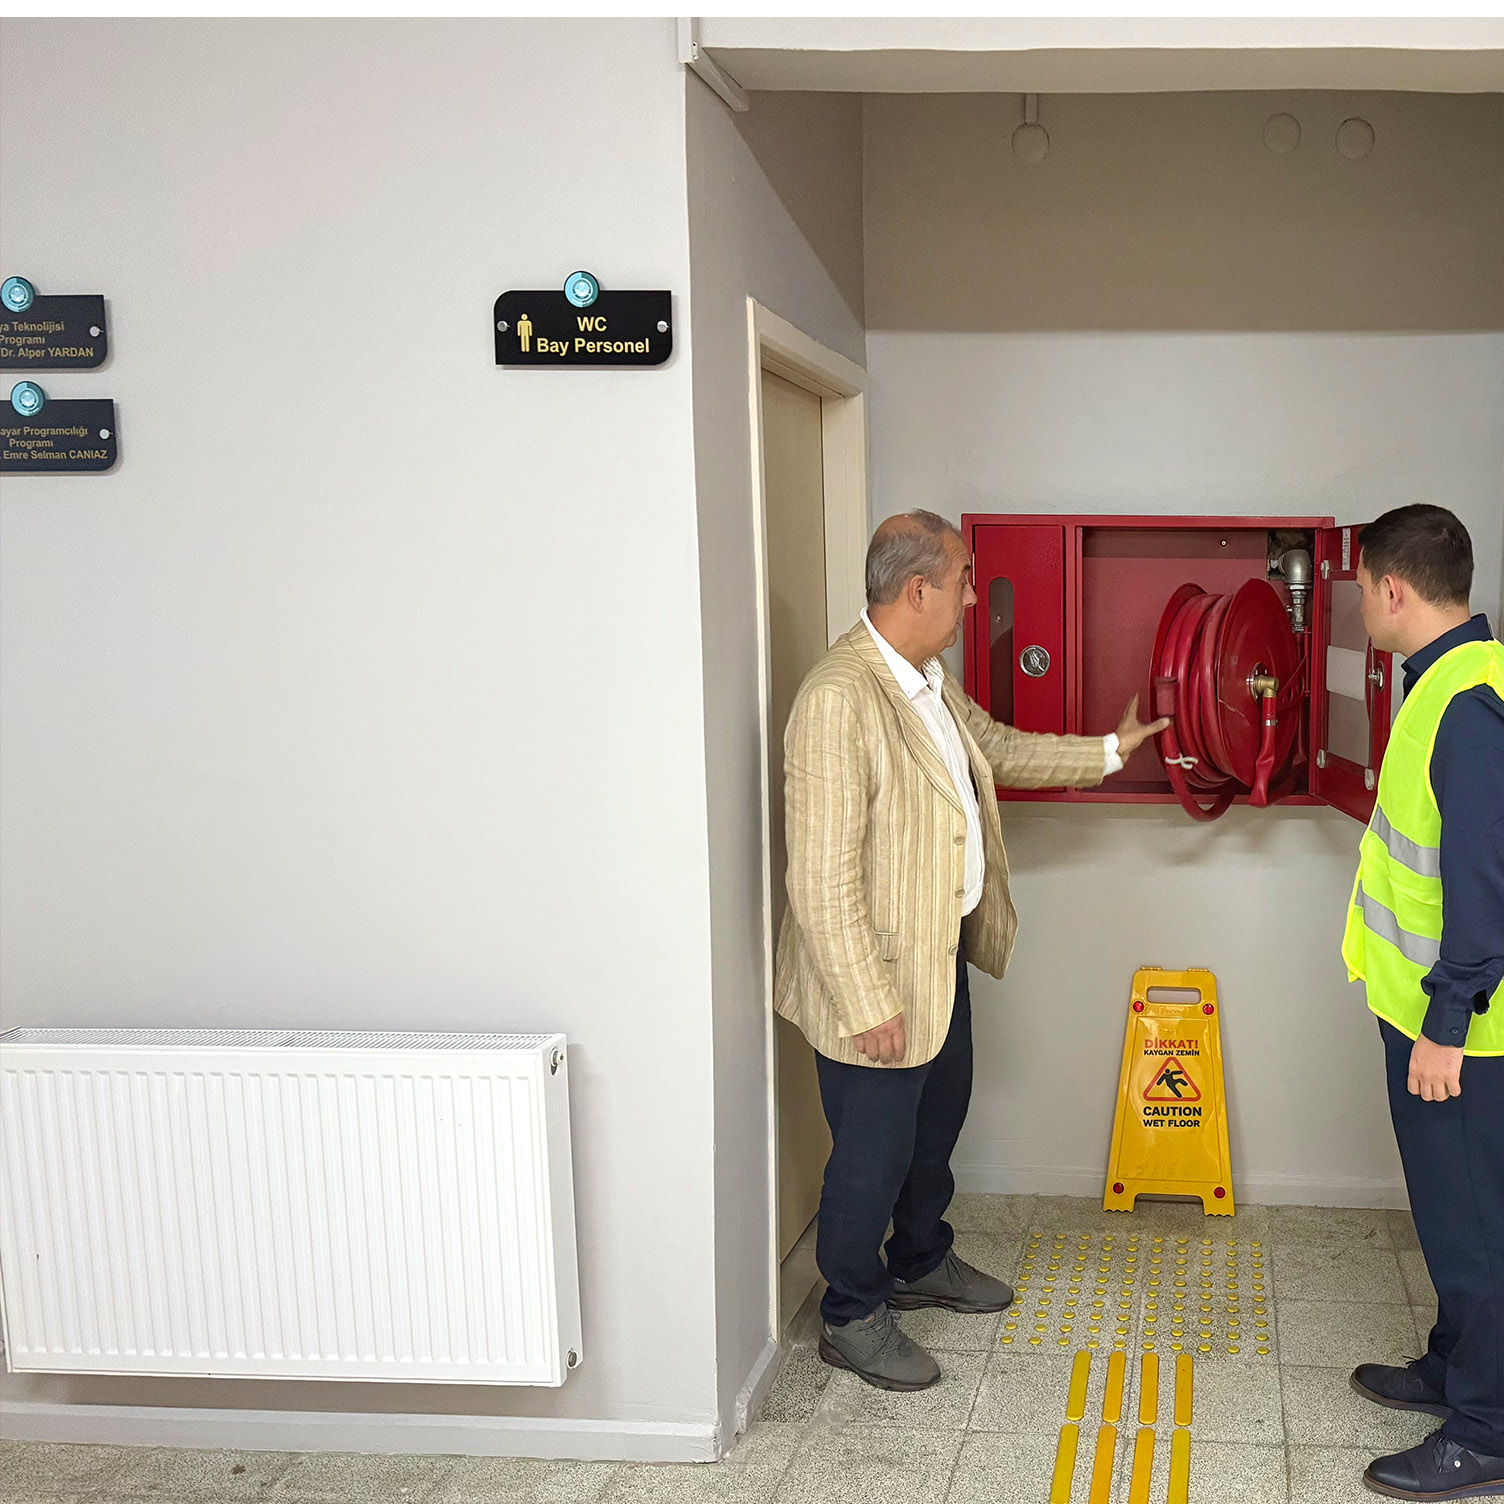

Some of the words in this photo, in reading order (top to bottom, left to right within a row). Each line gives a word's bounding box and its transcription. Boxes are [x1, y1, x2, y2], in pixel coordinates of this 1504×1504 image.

[577, 316, 608, 332] WC
[1, 347, 15, 357] Dr.
[18, 347, 46, 359] Alper
[48, 347, 94, 357] YARDAN
[537, 338, 569, 357] Bay
[574, 338, 650, 353] Personel
[0, 428, 21, 437] ayar
[23, 426, 88, 438] Programcılığı
[9, 438, 54, 449] Programı
[3, 450, 28, 459] Emre
[31, 450, 67, 459] Selman
[69, 450, 108, 459] CANIAZ
[1144, 1037, 1199, 1049] DİKKAT!
[1143, 1106, 1202, 1116] CAUTION
[1143, 1119, 1165, 1127] WET
[1168, 1119, 1200, 1127] FLOOR
